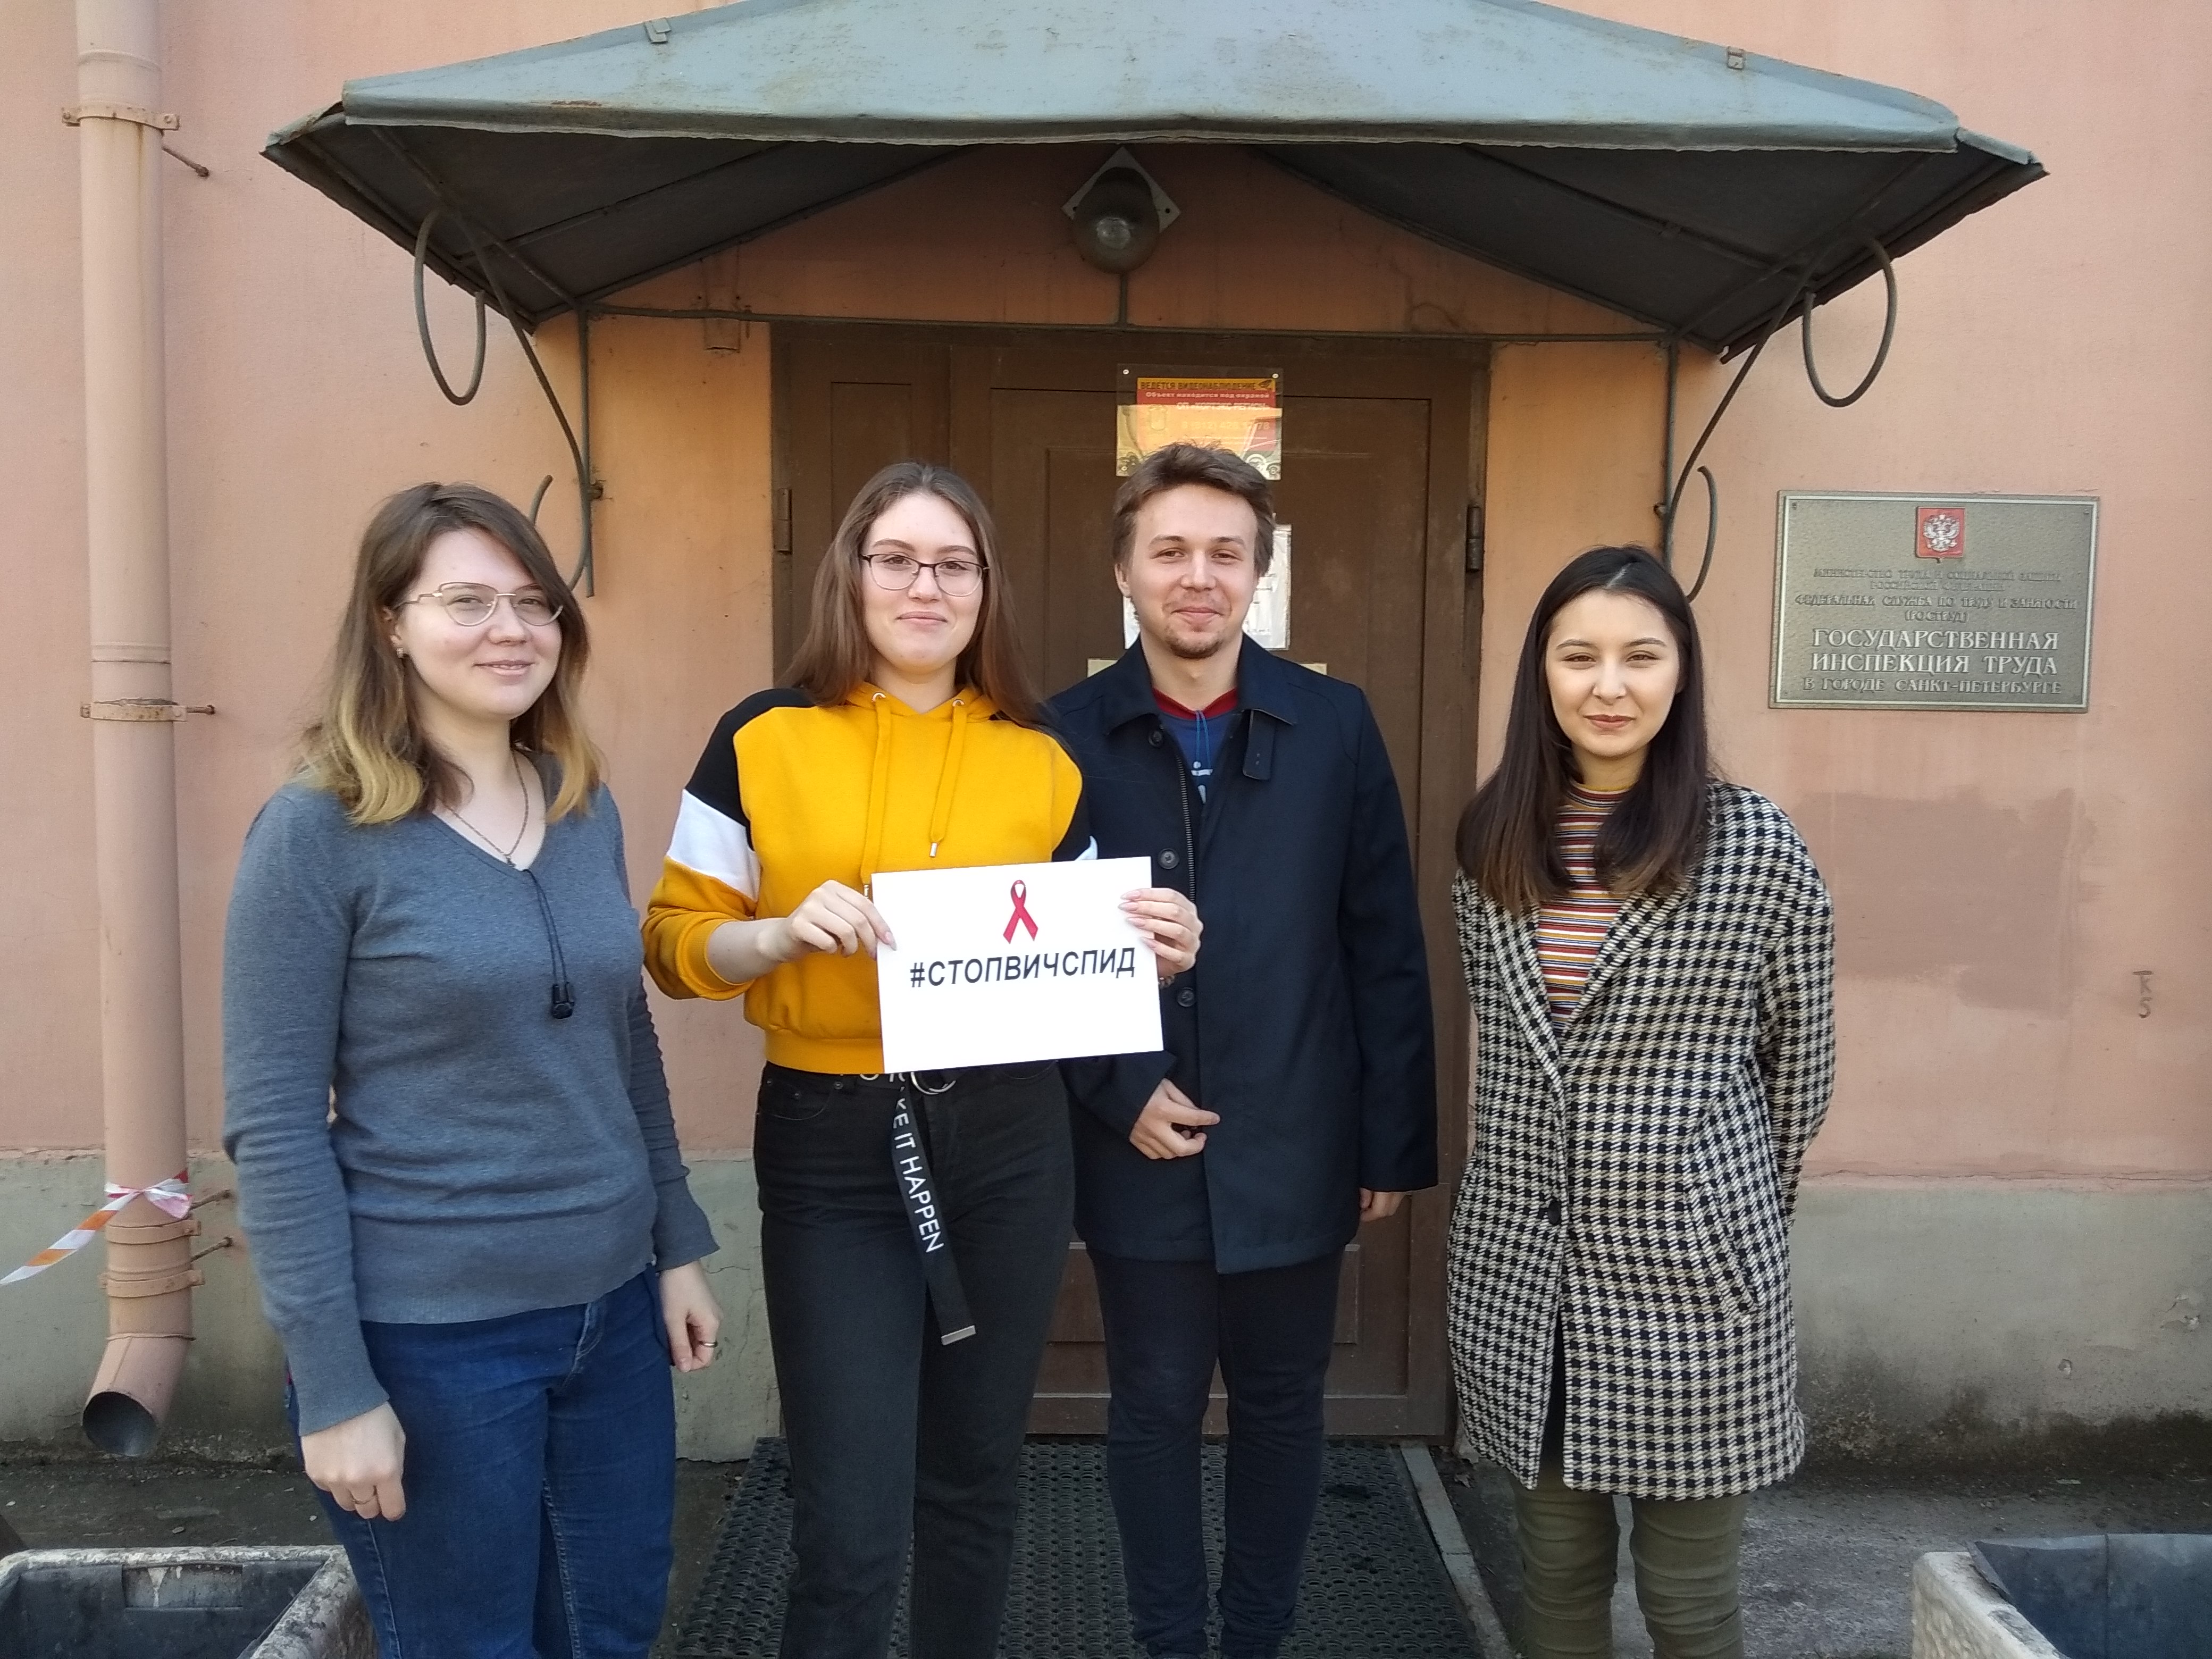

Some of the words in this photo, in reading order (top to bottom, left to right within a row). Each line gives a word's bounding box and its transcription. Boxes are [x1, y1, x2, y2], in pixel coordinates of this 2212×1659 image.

[1795, 594, 1876, 607] ФЕДЕРАЛЬНАЯ
[1881, 596, 1932, 607] СЛУЖБА
[1937, 597, 1954, 607] ПО
[1960, 597, 1993, 609] ТРУДУ
[1998, 598, 2008, 608] И
[2009, 598, 2076, 610] ЗАНЯТОСТИ
[1904, 609, 1970, 623] (РОСТРУД)
[1812, 628, 2059, 651] ГОСУДАРСТВЕННАЯ
[1812, 652, 1970, 676] ИНСПЕКЦИЯ
[1982, 655, 2059, 678] ТРУДА
[1803, 677, 1815, 691] В
[1822, 677, 1885, 693] ГОРОДЕ
[1895, 678, 2062, 694] САНКТ-ПЕТЕРБУРГЕ
[909, 947, 1136, 988] #СТОПВИЧСПИД
[894, 1133, 916, 1149] IT
[900, 1156, 944, 1253] HAPPEN
